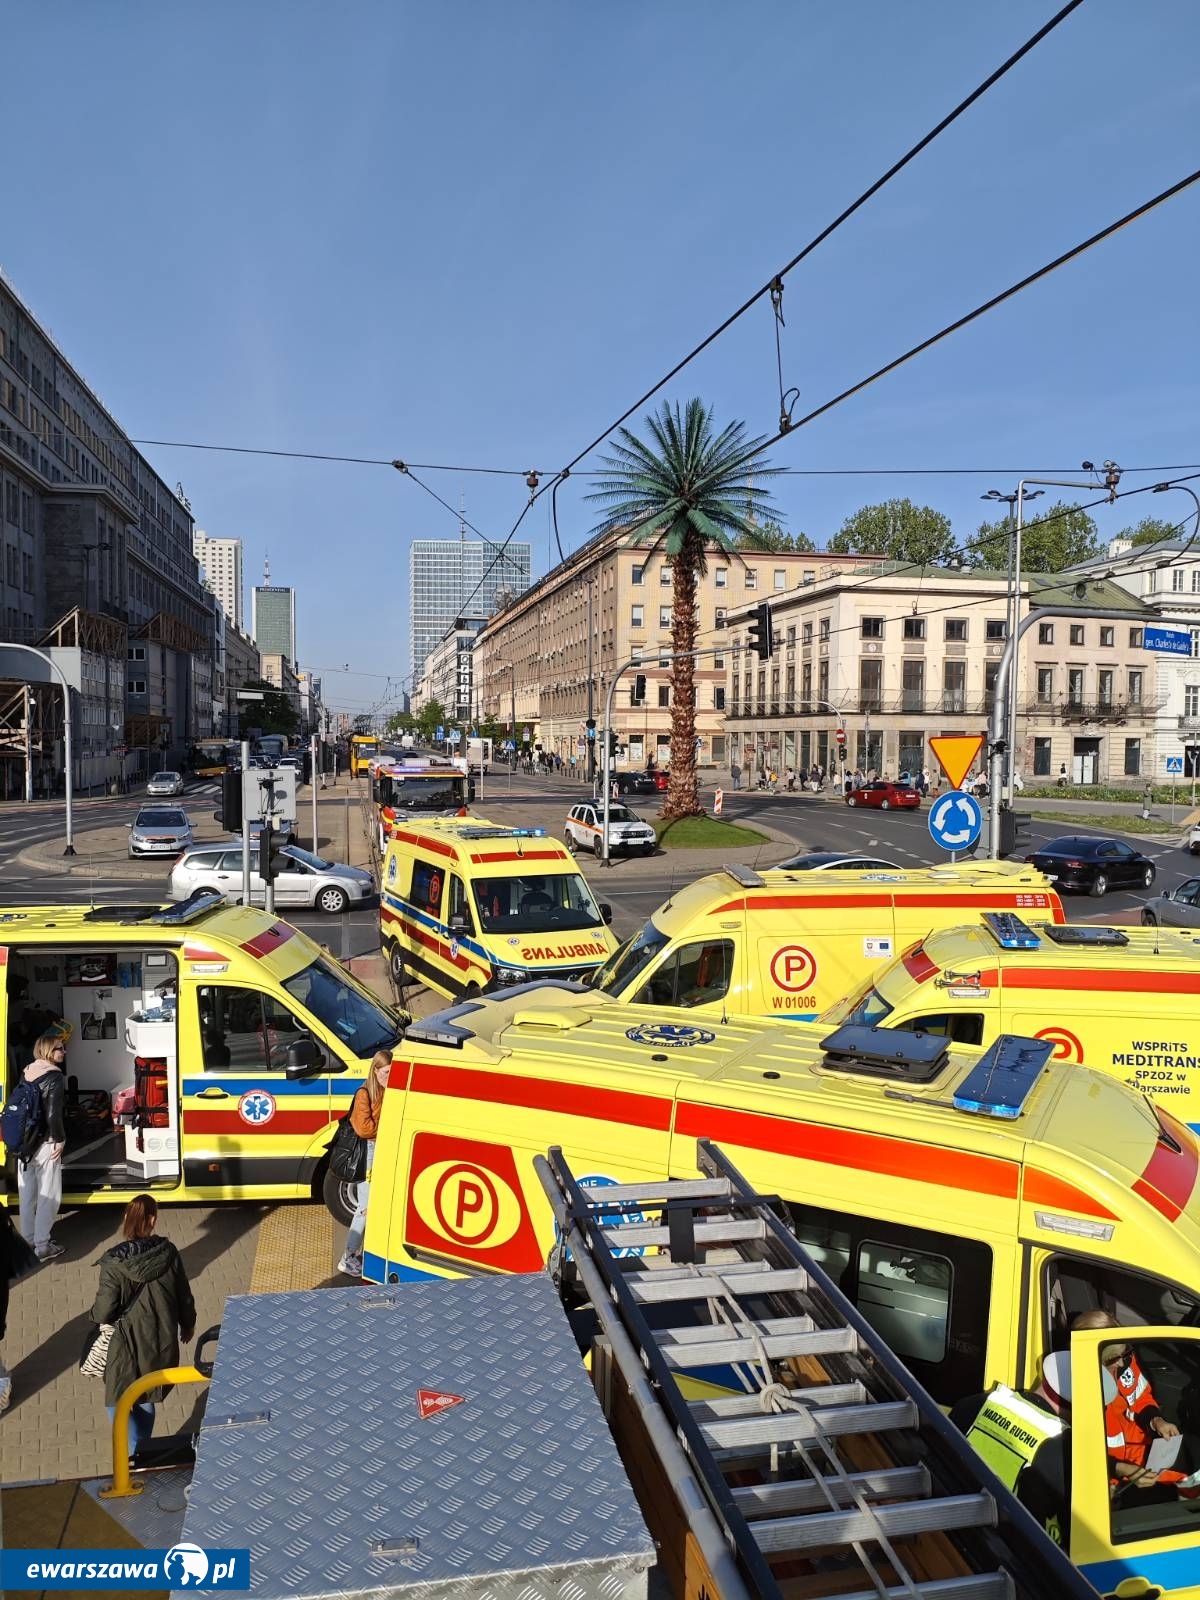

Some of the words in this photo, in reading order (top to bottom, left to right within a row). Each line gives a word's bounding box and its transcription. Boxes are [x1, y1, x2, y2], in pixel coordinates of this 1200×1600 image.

[461, 655, 469, 702] Orbis
[785, 956, 806, 981] P
[772, 996, 783, 1008] W
[785, 996, 816, 1008] 01006
[1132, 1041, 1188, 1052] WSPRiTS
[1135, 1070, 1173, 1081] SPZOZ
[1176, 1073, 1187, 1081] w
[1135, 1083, 1190, 1094] arszawie
[456, 1180, 483, 1228] P
[982, 1408, 1012, 1430] NADZÓR
[1009, 1424, 1038, 1448] RUCHU
